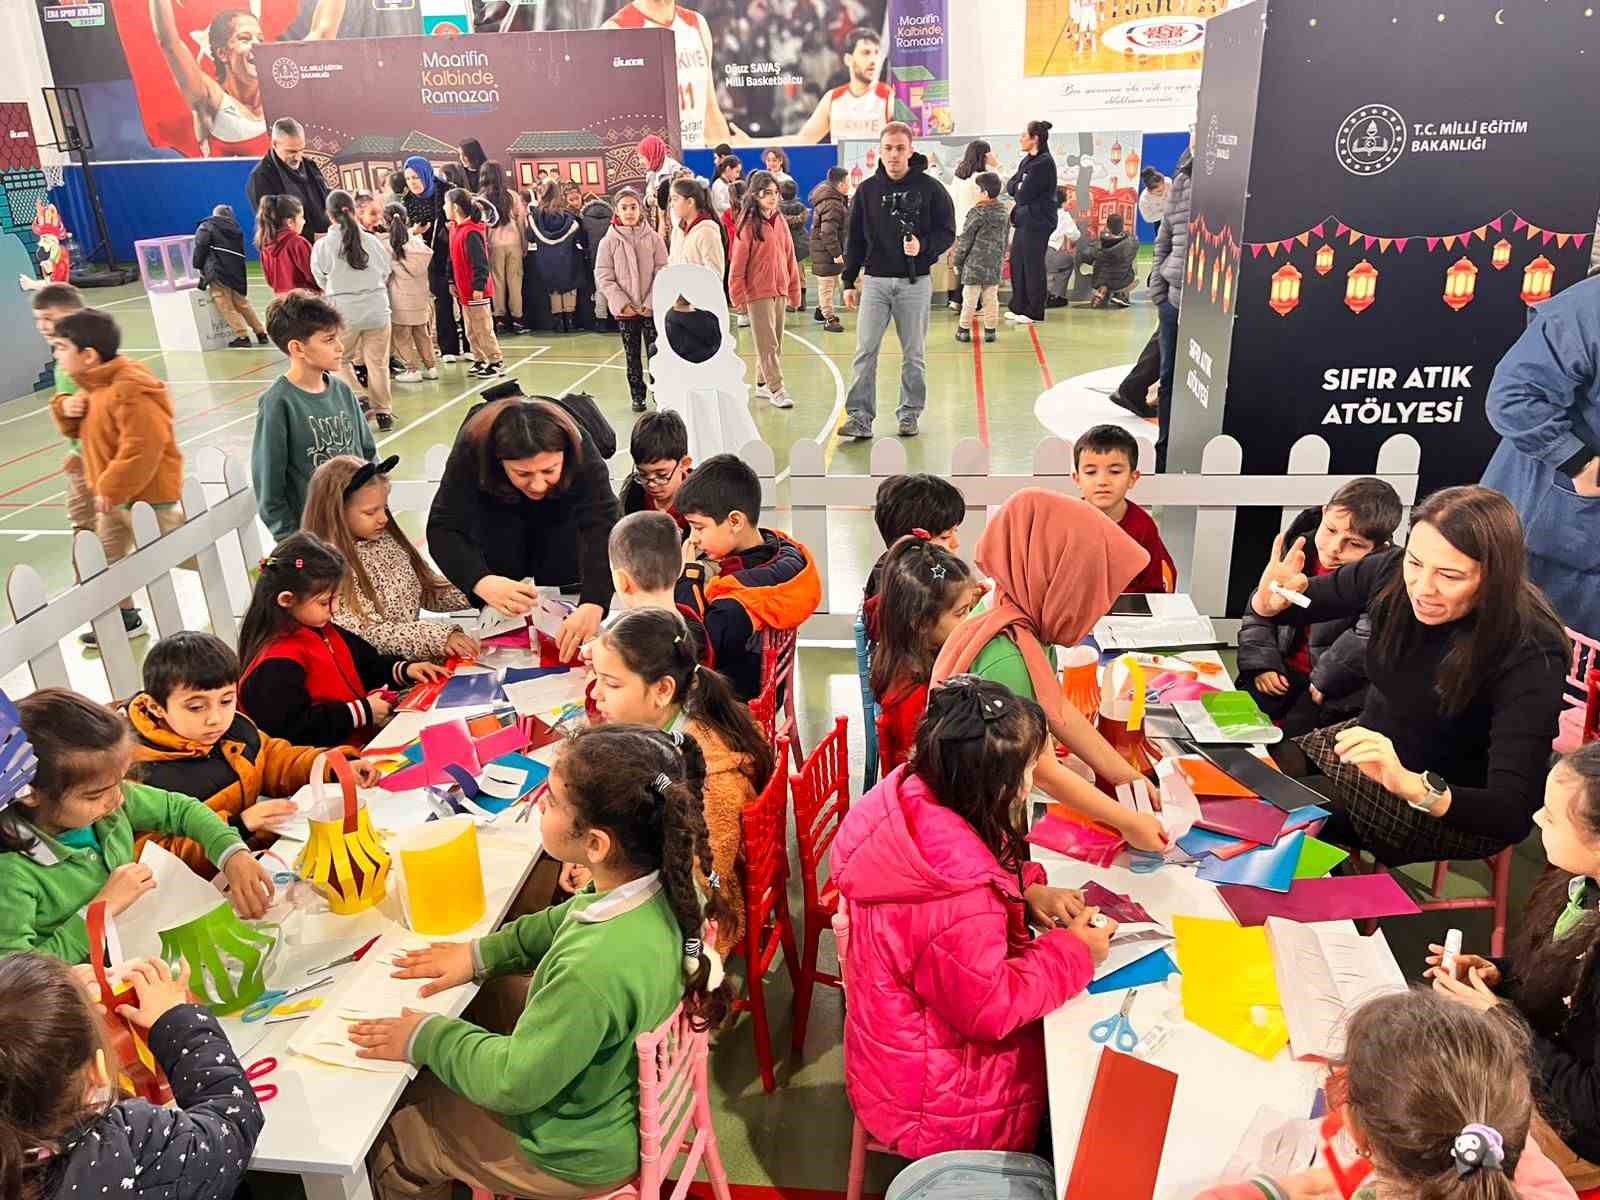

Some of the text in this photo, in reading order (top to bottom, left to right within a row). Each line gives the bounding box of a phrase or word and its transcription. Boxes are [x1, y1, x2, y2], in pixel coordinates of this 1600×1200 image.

[899, 13, 940, 26] Maarifin
[897, 25, 942, 37] Kalbinde
[896, 36, 944, 48] Ramazan
[422, 49, 489, 68] Maarifin
[725, 62, 781, 76] Oğuz SAVAŞ
[421, 69, 495, 86] Kalbinde
[725, 75, 803, 88] Milli Basketbolcu
[421, 88, 500, 105] Ramazan
[1413, 119, 1528, 136] T.C. MİLLİ EĞİTİM
[1411, 136, 1487, 152] BAKANLIĞI
[1321, 365, 1473, 391] SIFIR ATIK
[1321, 395, 1464, 425] ATÖLYESİ
